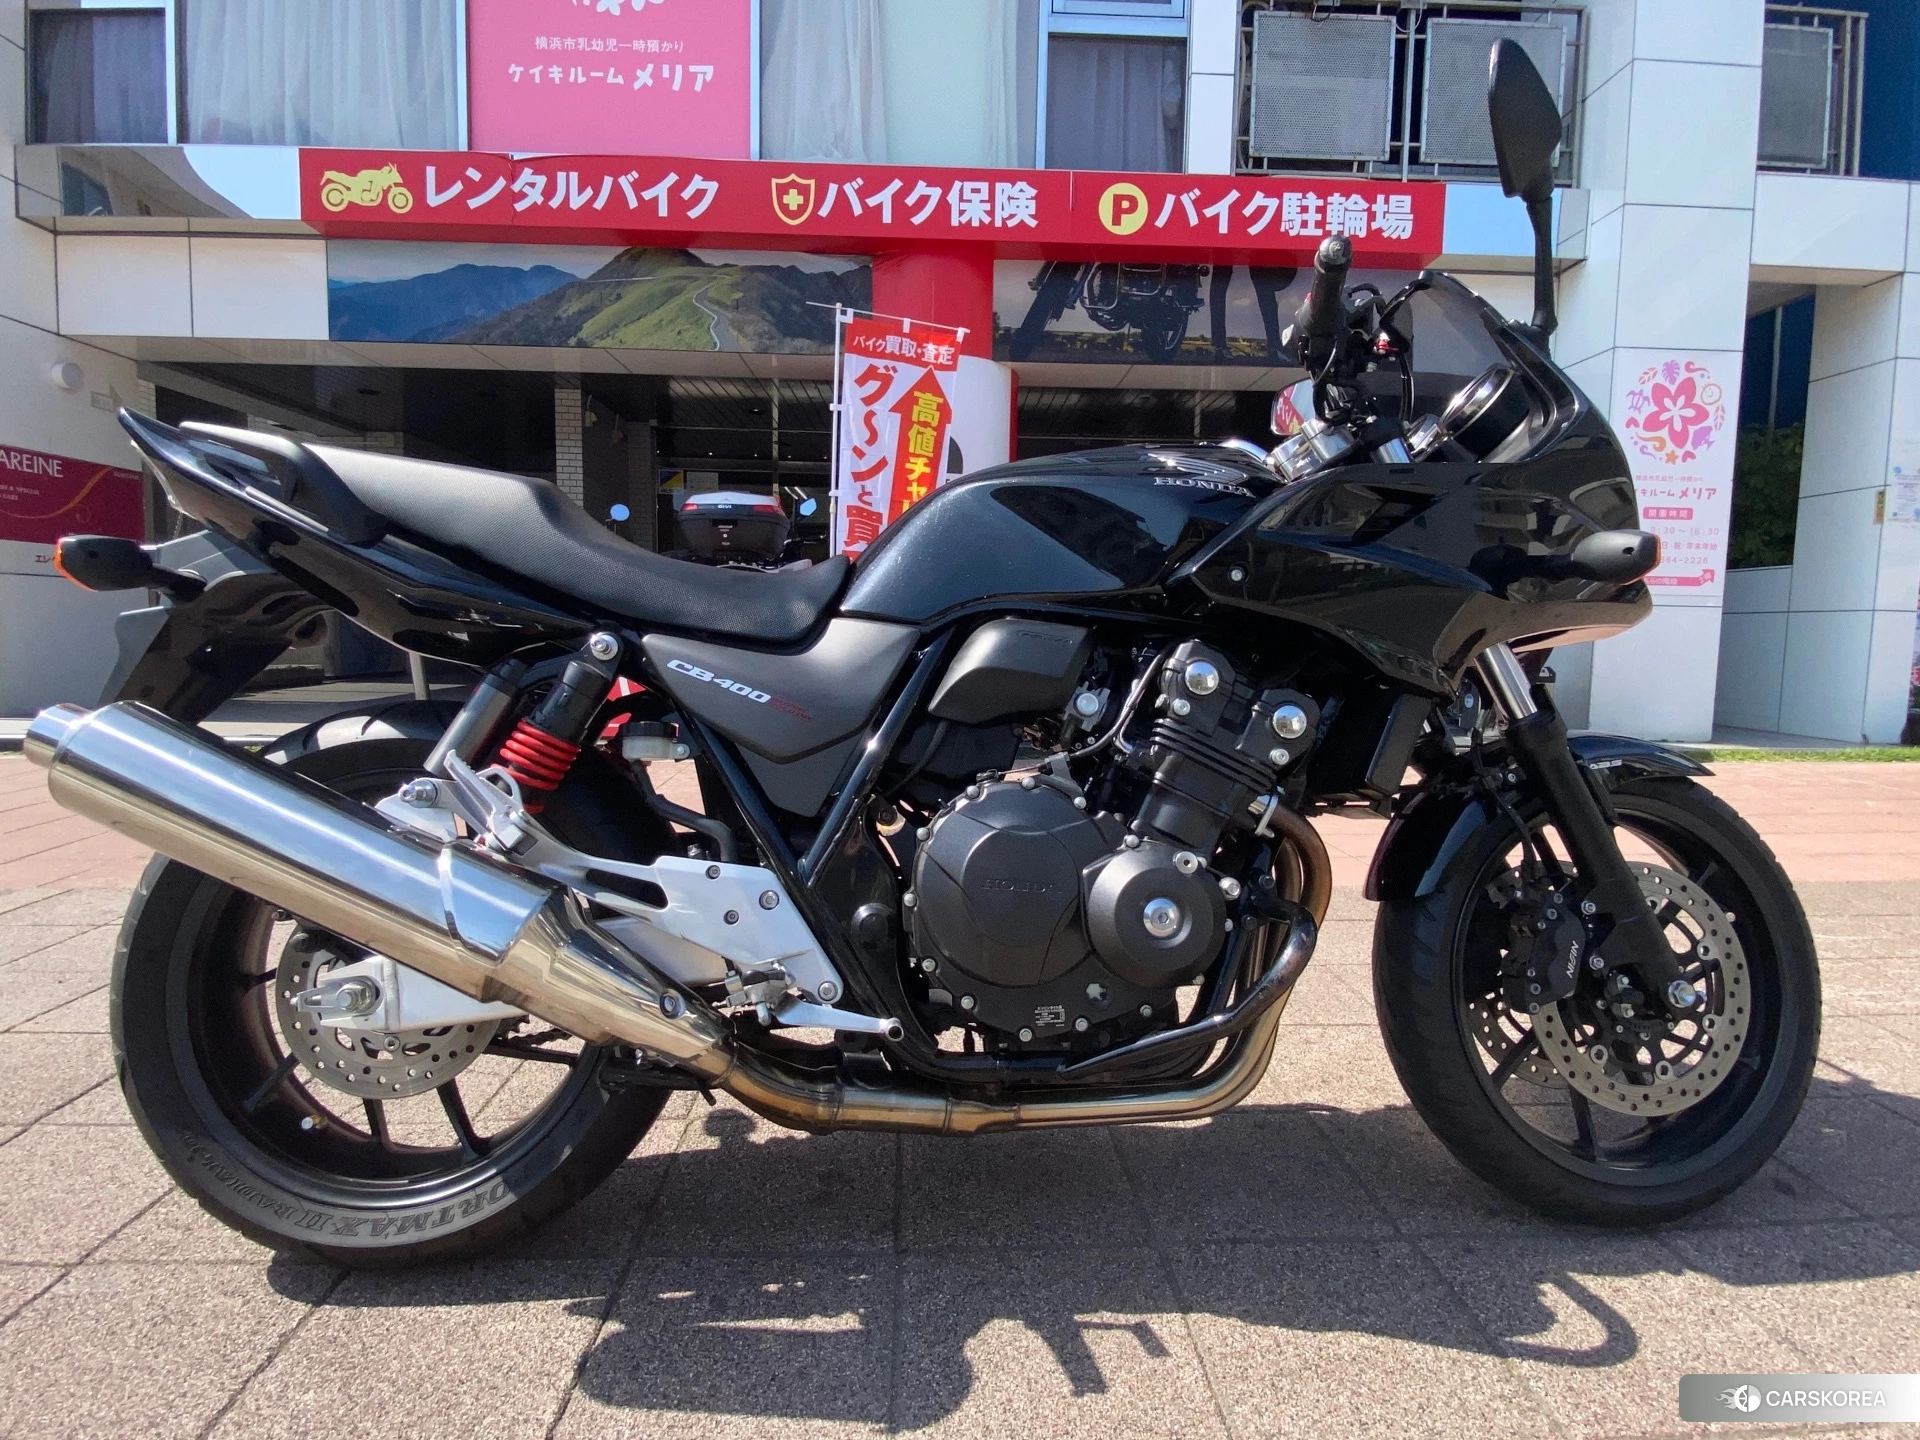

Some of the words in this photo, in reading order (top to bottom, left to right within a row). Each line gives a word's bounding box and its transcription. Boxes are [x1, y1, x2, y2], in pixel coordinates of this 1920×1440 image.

[535, 36, 684, 53] 横浜市乳幼児一時預かり
[508, 63, 624, 85] ケイキルーム
[633, 63, 714, 92] メリア
[425, 165, 719, 219] レンタルバイク
[817, 176, 1039, 228] バイク保険
[1154, 188, 1414, 240] バイク駐輪場
[1153, 477, 1257, 499] HONDA
[1679, 487, 1717, 500] メリア
[667, 659, 772, 703] CB400
